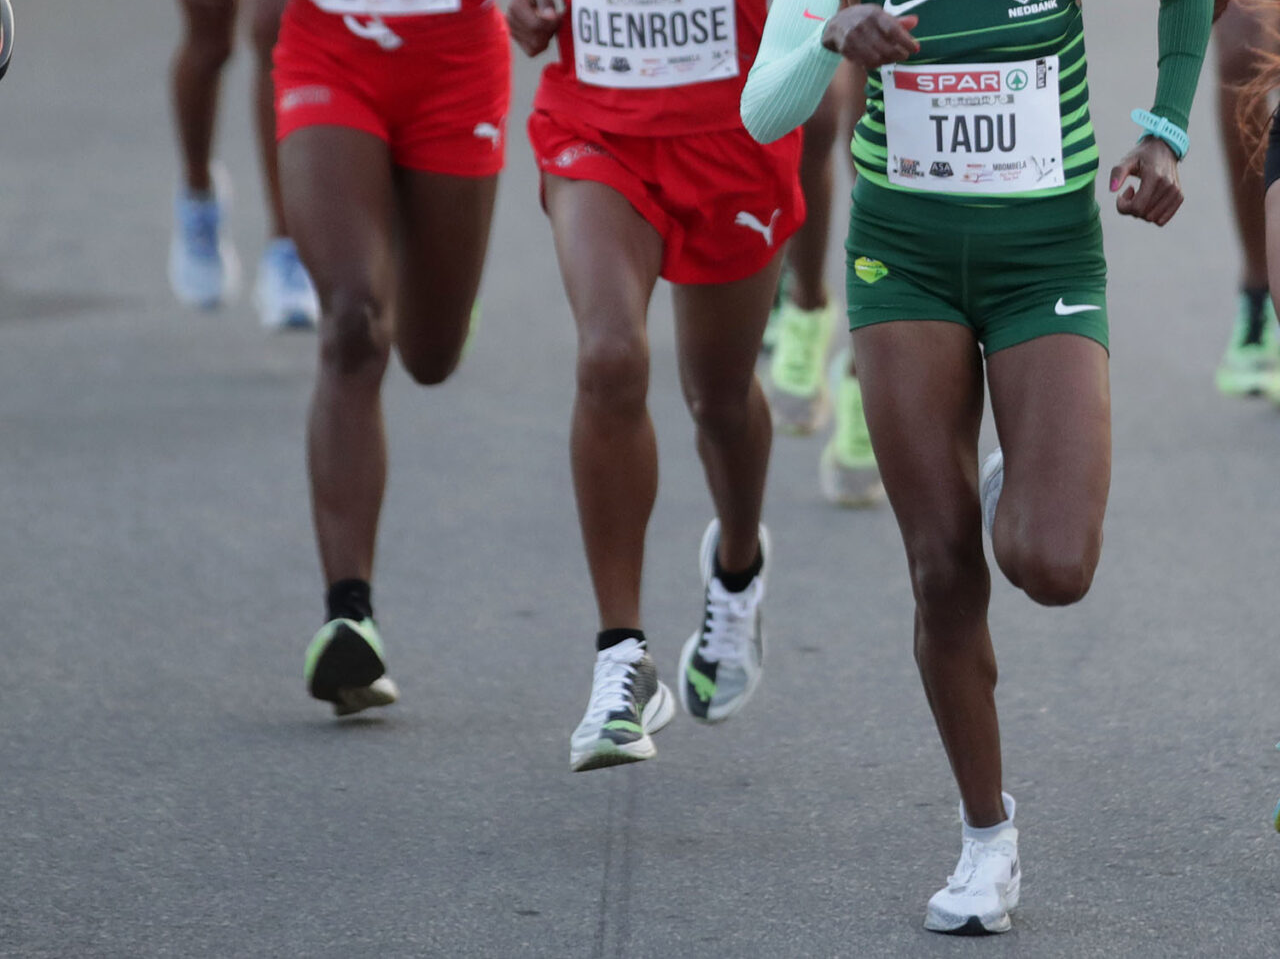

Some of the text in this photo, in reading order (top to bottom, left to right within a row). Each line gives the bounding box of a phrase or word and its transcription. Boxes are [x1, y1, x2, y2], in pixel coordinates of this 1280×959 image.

[577, 5, 728, 49] GLENROSE
[917, 75, 999, 92] SPAR
[929, 112, 1017, 154] TADU
